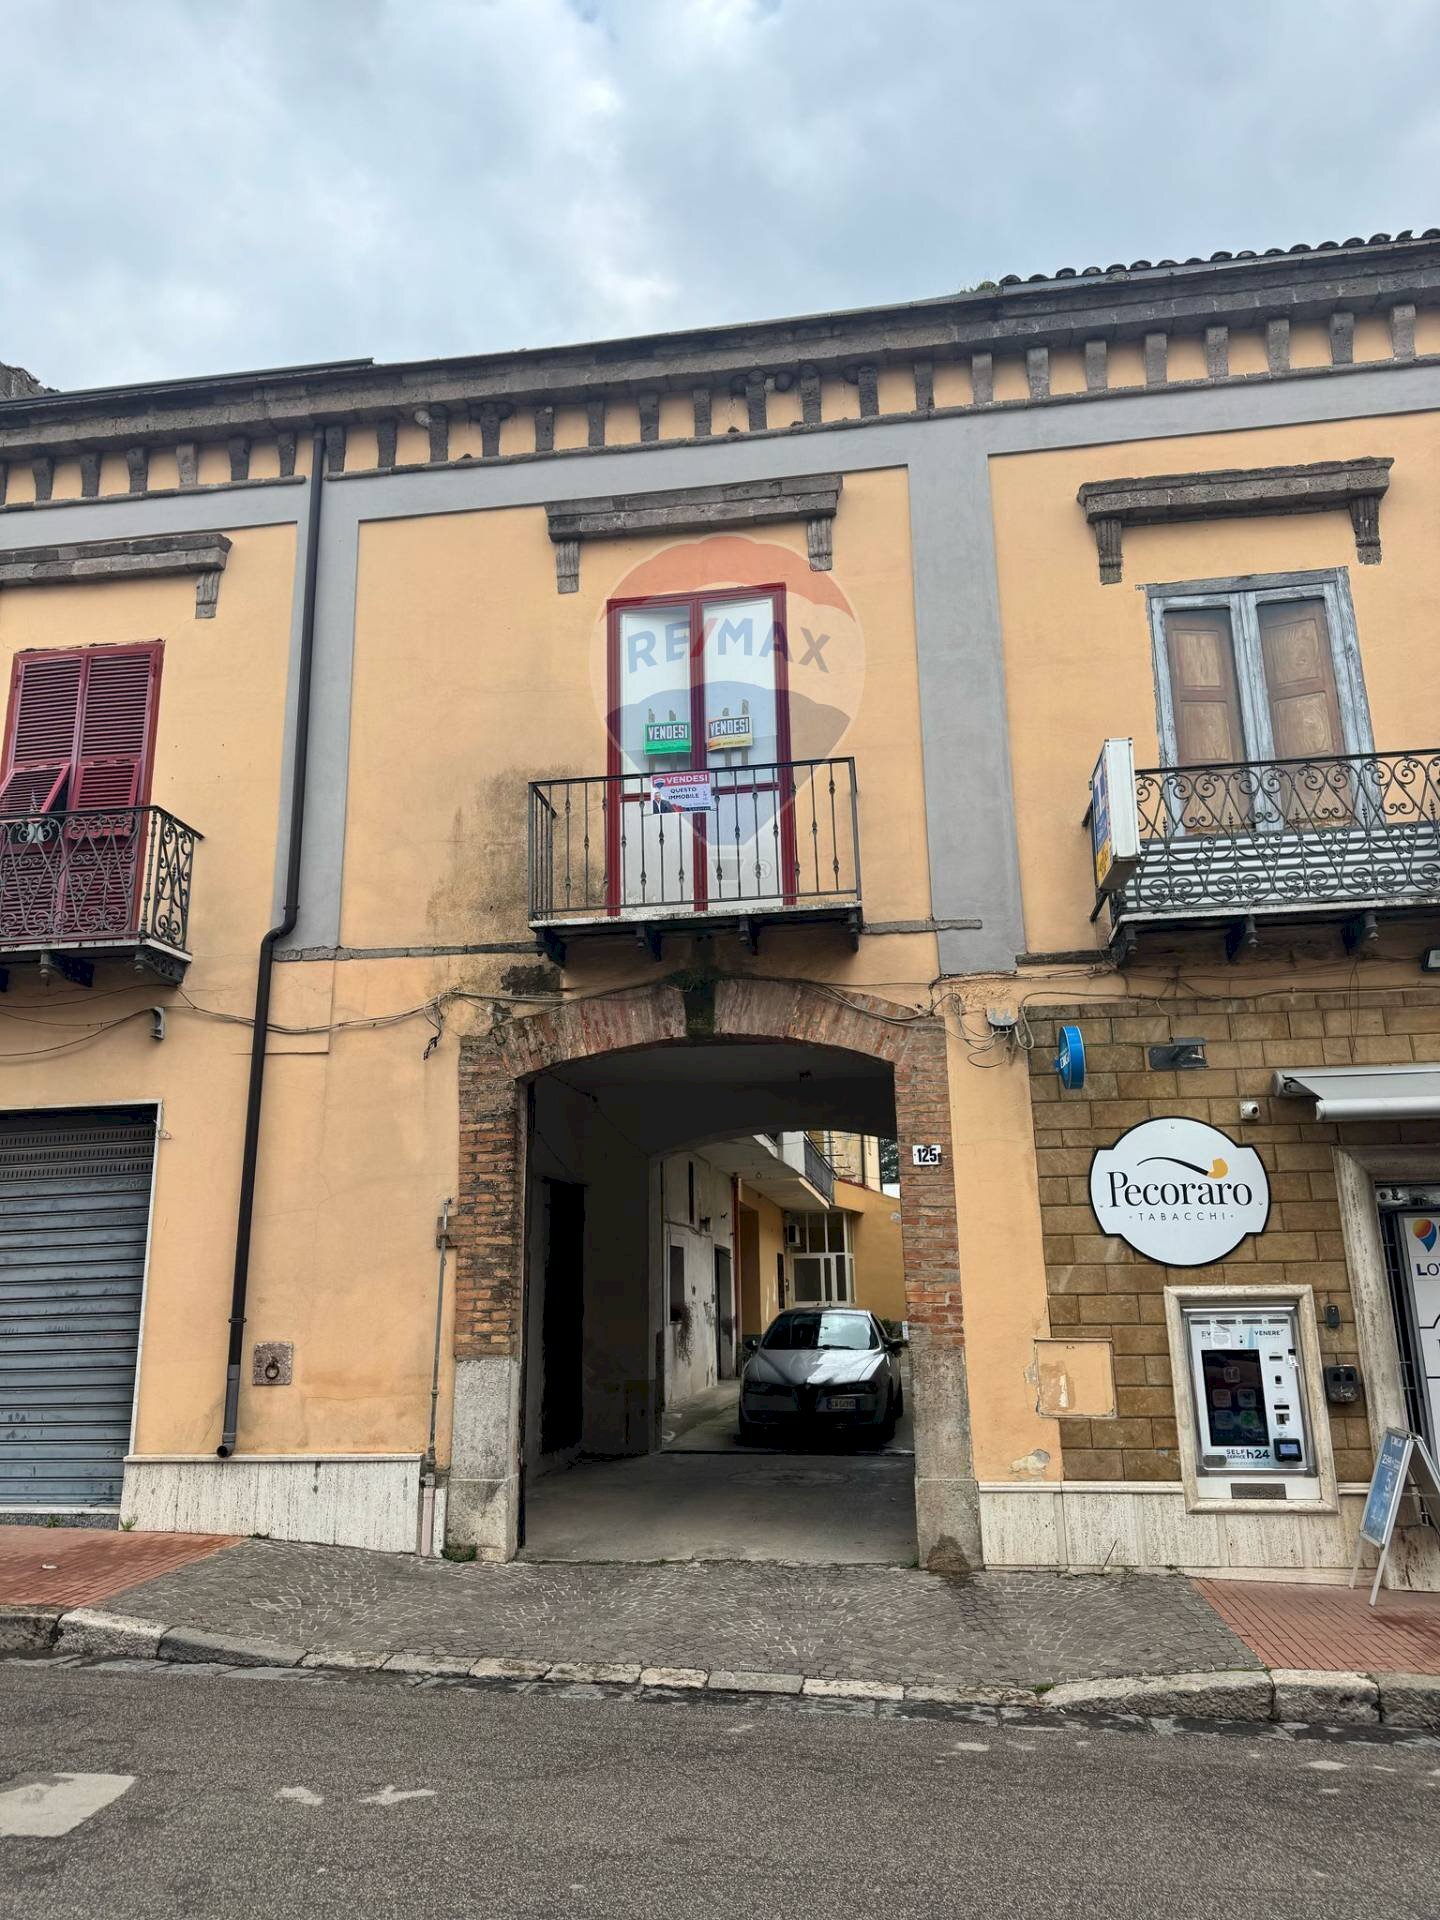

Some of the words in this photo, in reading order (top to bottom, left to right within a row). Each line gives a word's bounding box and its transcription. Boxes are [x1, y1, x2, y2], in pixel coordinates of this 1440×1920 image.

[648, 724, 688, 740] VENDESI
[709, 718, 749, 736] VENDESI
[666, 774, 708, 784] VENDESI
[917, 1147, 937, 1162] 125
[1107, 1171, 1253, 1208] Pecoraro
[1138, 1212, 1226, 1221] TABACCHI
[1416, 1262, 1440, 1276] LO
[1246, 1448, 1271, 1459] h24
